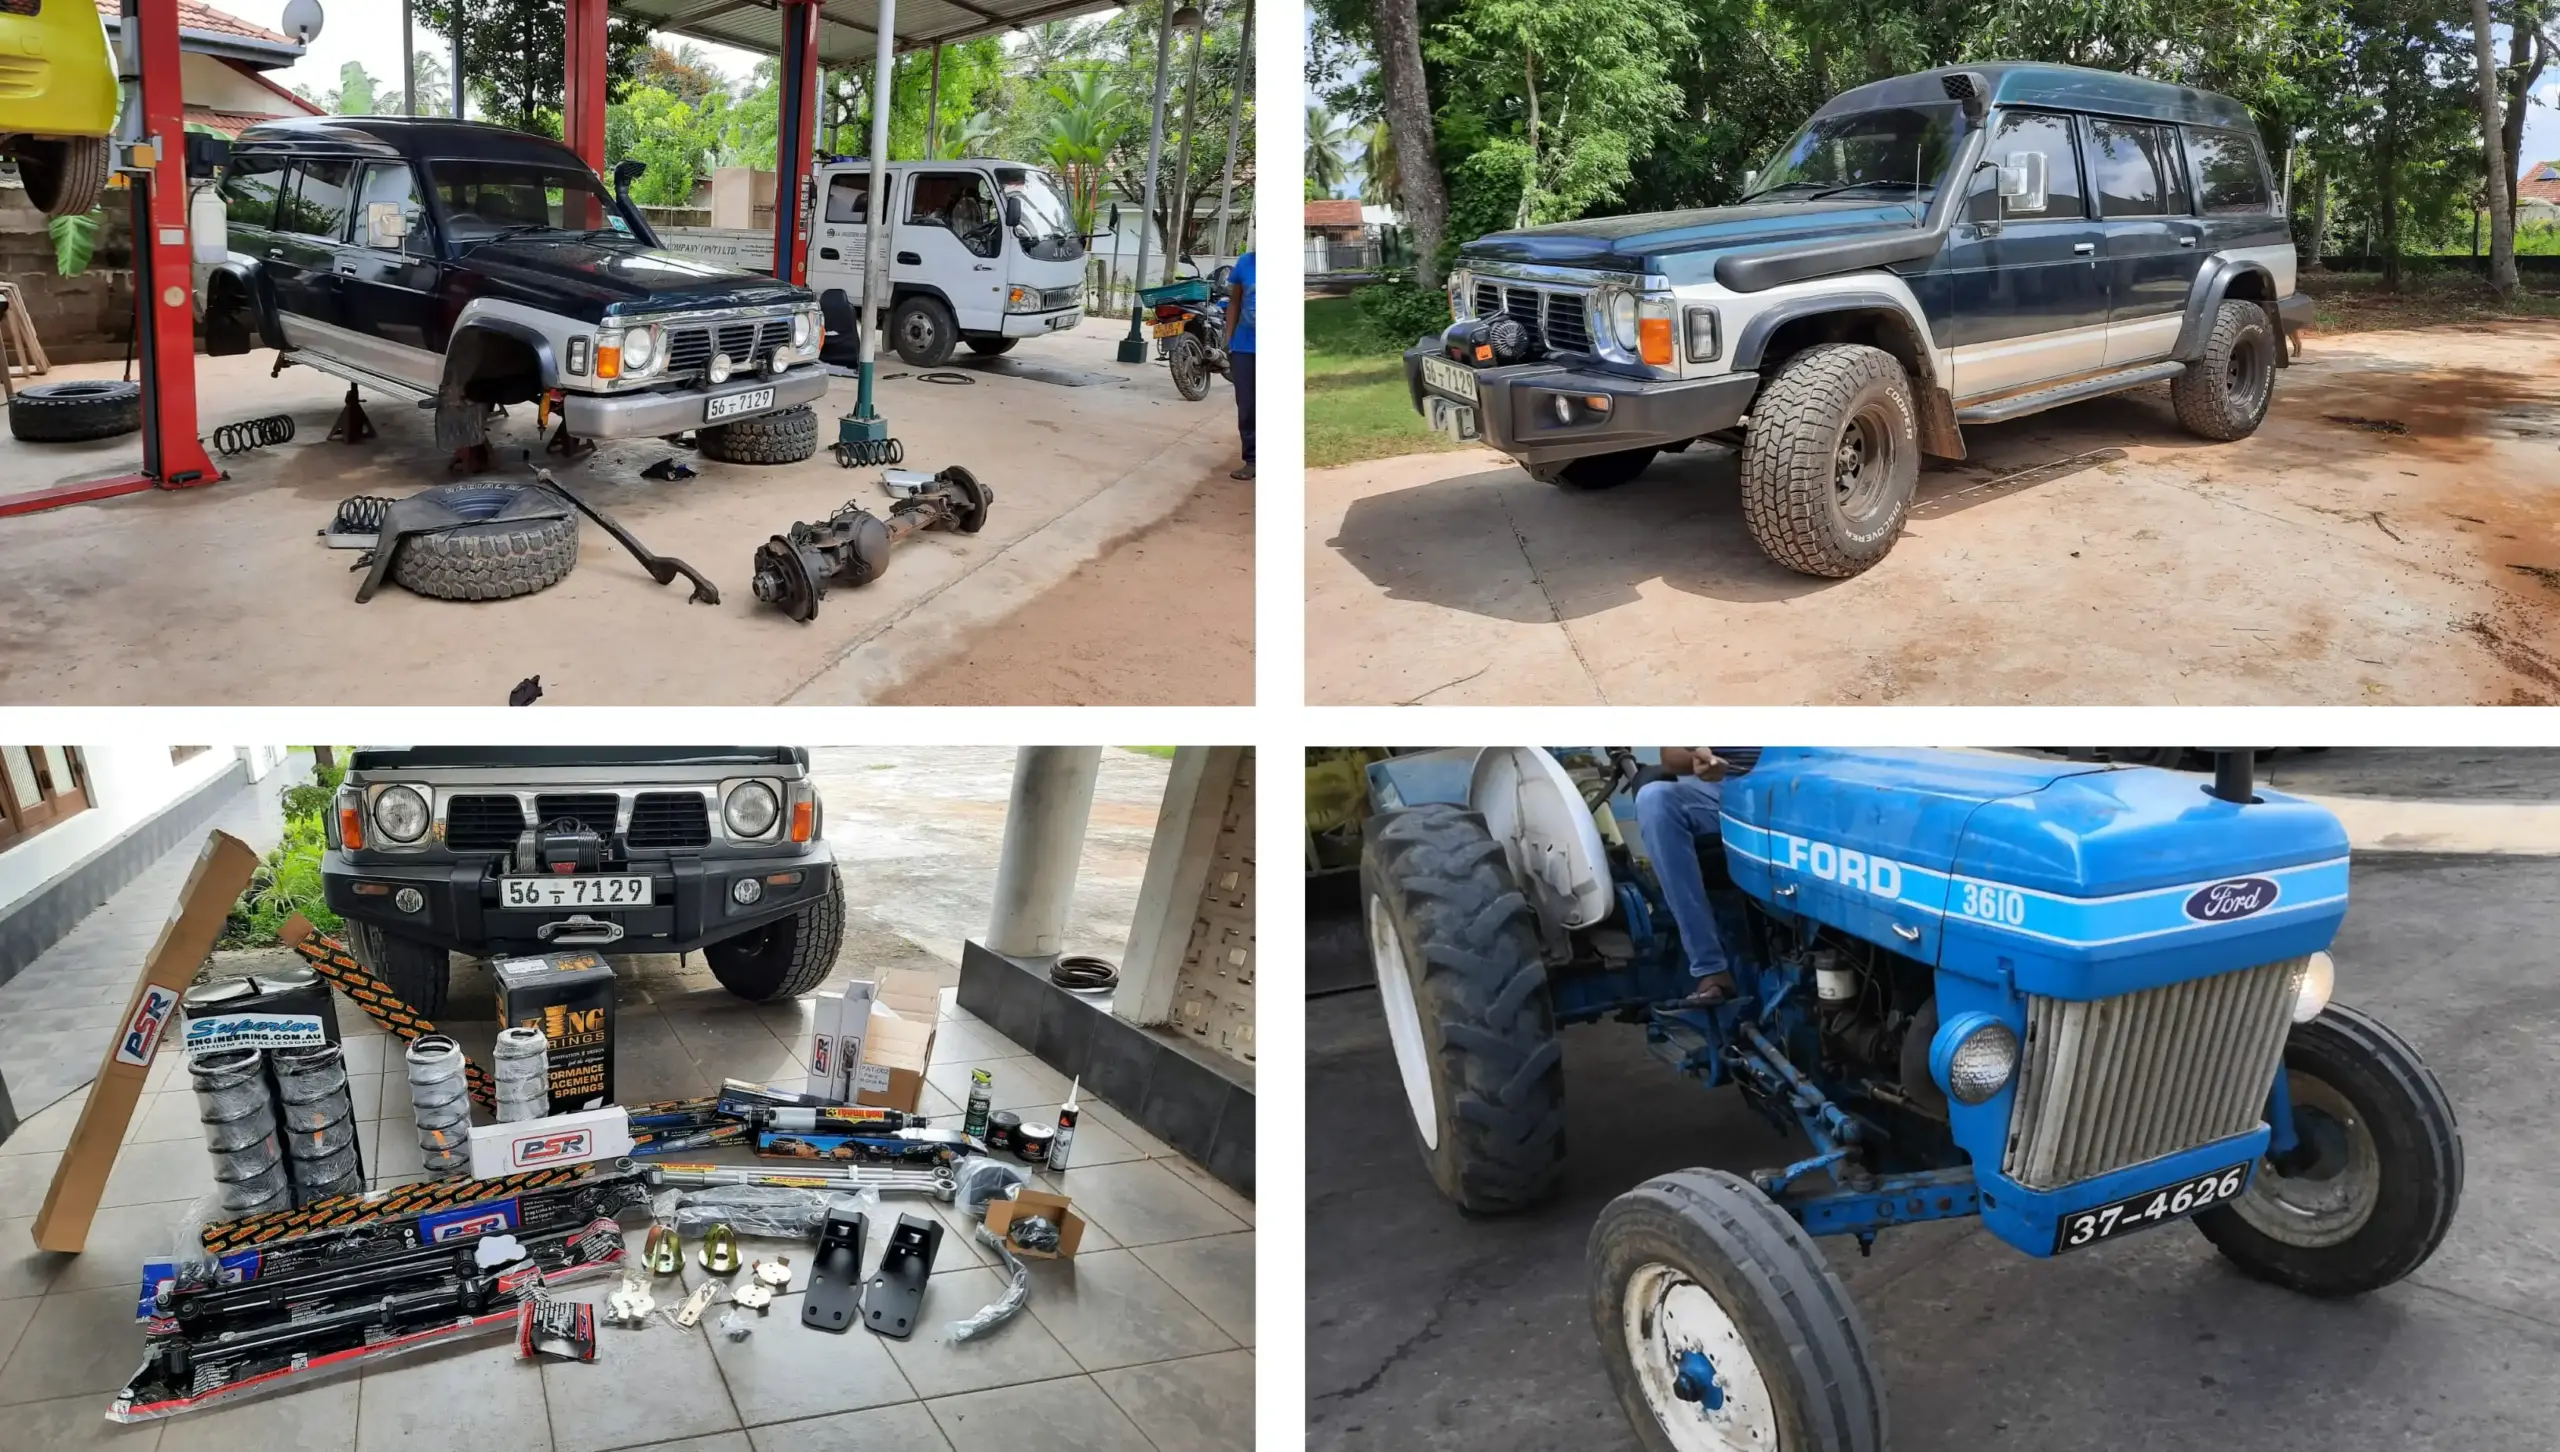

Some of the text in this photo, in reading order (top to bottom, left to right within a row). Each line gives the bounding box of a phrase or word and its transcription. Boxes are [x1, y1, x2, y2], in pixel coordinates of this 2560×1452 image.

[700, 244, 721, 255] (PVT)
[1052, 247, 1073, 258] JAC
[1424, 359, 1474, 396] 56 7129
[711, 390, 770, 416] 56 7129
[1885, 386, 1913, 440] COOPER
[1845, 500, 1902, 543] DISCOVERER
[1788, 835, 1902, 899] FORD
[510, 879, 642, 904] 56 7129
[2204, 882, 2262, 917] Ford
[1963, 884, 2025, 926] 3610
[124, 991, 172, 1060] PSR
[186, 1018, 320, 1039] Superior
[187, 1033, 321, 1047] ENGINEERING.COM.AU
[188, 1042, 236, 1052] PREMIUM
[547, 1032, 605, 1049] RINGS
[814, 1038, 829, 1074] PSR
[549, 1063, 604, 1081] ORMANCE
[551, 1073, 605, 1090] ACEMENT
[554, 1083, 605, 1099] SPRINGS
[520, 1134, 585, 1161] PSR
[2070, 1167, 2241, 1245] 37-4626
[442, 1217, 500, 1239] PSR
